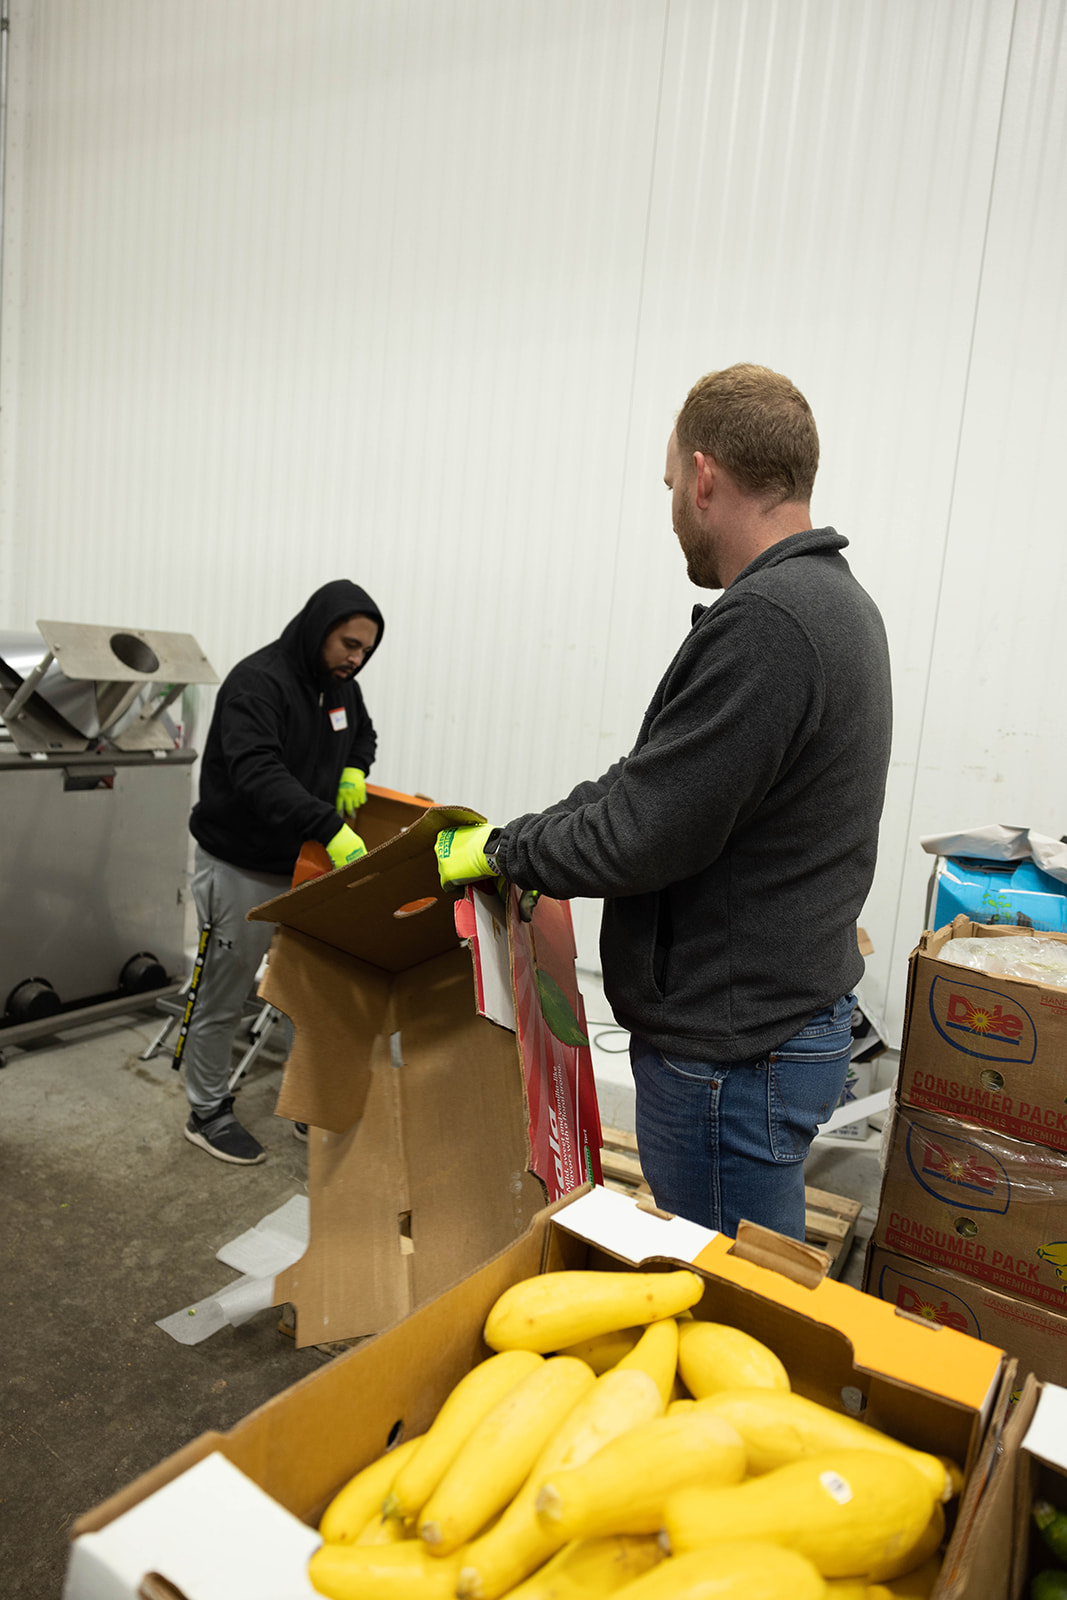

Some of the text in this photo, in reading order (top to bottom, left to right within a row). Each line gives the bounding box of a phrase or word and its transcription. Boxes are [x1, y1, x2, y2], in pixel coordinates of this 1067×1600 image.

[947, 993, 1023, 1037] Dole
[553, 1065, 562, 1115] vanilla-like
[912, 1092, 957, 1112] PREMIUM
[913, 1070, 1067, 1132] CONSUMER PACK
[557, 1117, 565, 1135] and
[563, 1130, 571, 1152] with
[560, 1137, 568, 1166] sweet
[567, 1154, 575, 1188] flavors
[923, 1142, 998, 1188] Dole
[888, 1233, 931, 1258] PREMIUM
[933, 1250, 979, 1275] BANANAS
[992, 1269, 1041, 1296] PREMIUM
[889, 1212, 1041, 1282] CONSUMER PACK
[896, 1284, 968, 1332] Dole
[983, 1295, 1020, 1315] HANDLE
[1022, 1311, 1048, 1326] WITH
